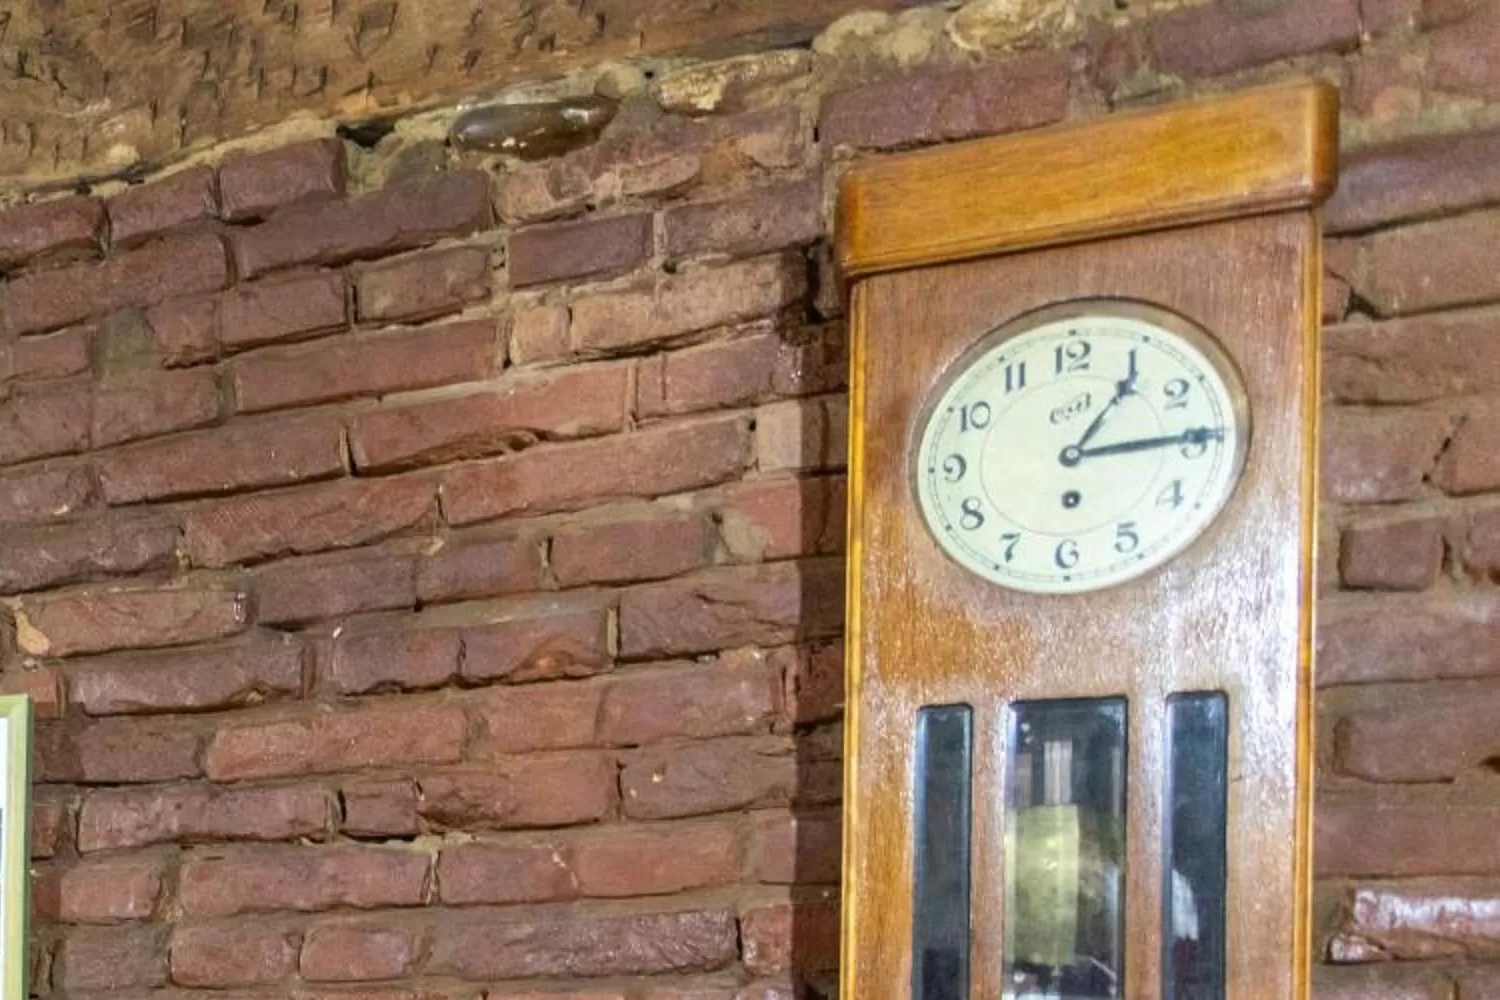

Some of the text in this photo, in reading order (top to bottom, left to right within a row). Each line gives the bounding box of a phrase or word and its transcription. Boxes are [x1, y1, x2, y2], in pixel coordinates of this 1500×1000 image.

[1054, 340, 1092, 374] 12
[1004, 362, 1027, 393] 11
[1162, 378, 1190, 411] 2
[959, 401, 992, 433] 10
[942, 454, 967, 483] 9
[1155, 480, 1184, 510] 4
[959, 497, 985, 530] 8
[1000, 532, 1021, 563] 7
[1114, 522, 1140, 553] 5
[1054, 539, 1080, 569] 6
